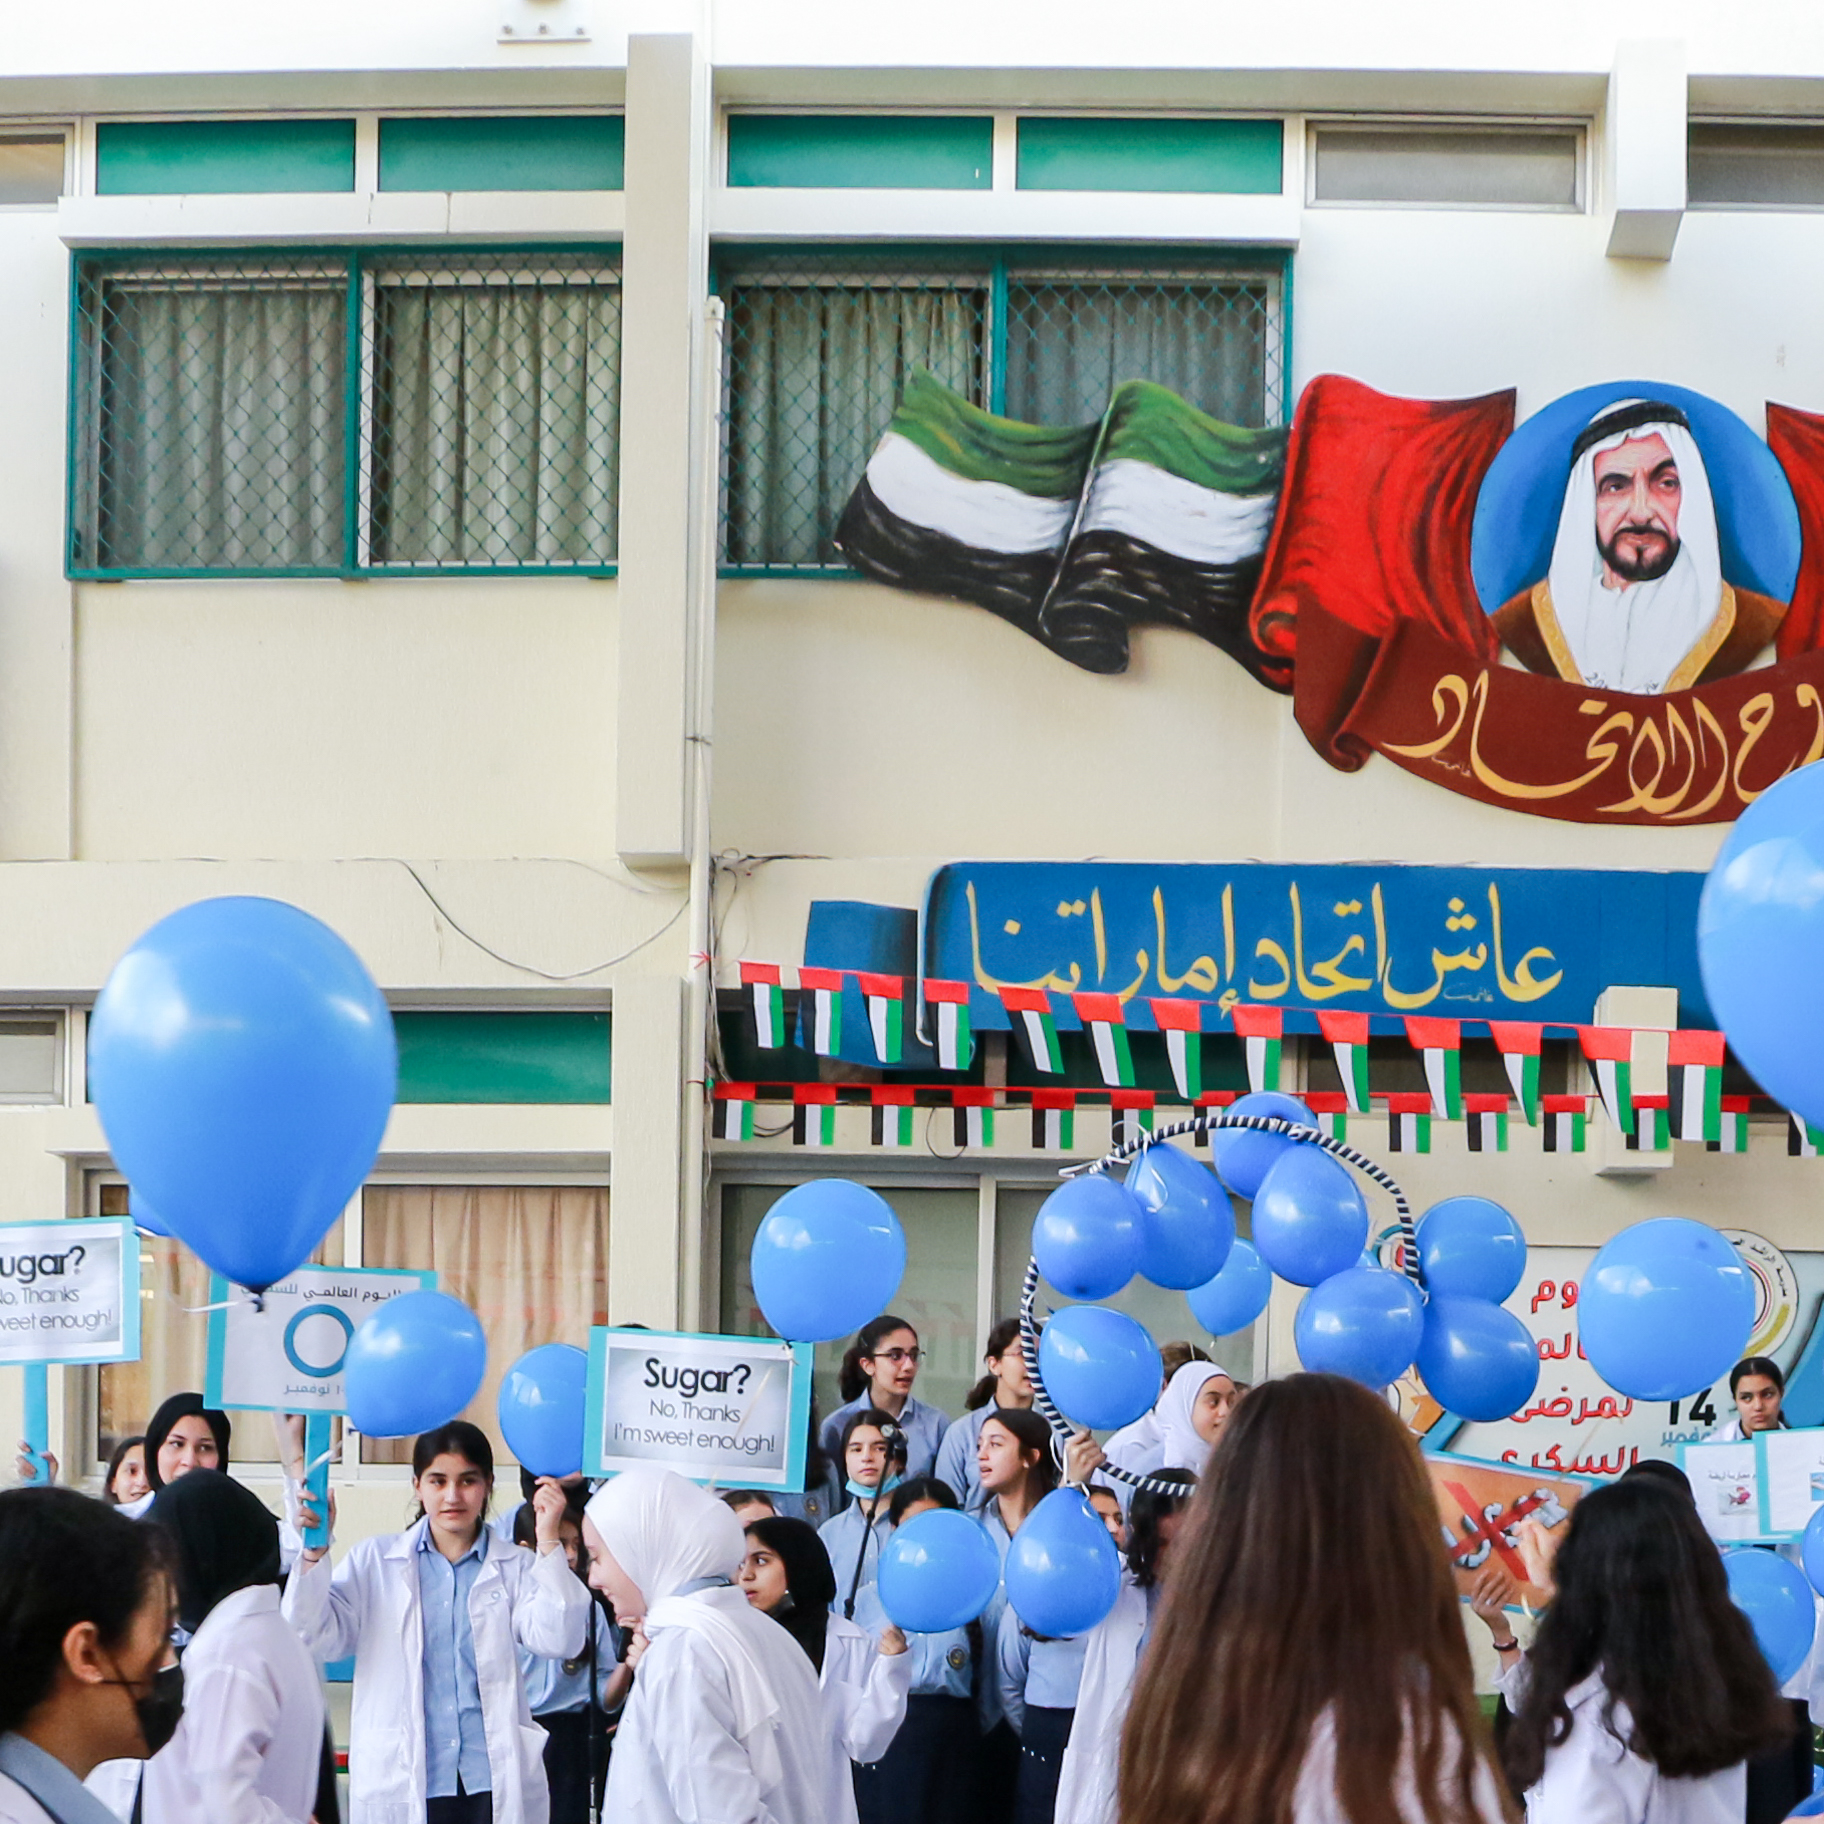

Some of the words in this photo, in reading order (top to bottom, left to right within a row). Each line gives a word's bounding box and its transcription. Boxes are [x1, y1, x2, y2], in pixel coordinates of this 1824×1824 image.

[965, 881, 1241, 1019] إماراتنا
[1248, 882, 1387, 1001] اتحاد
[1382, 882, 1563, 1009] عاش
[22, 1286, 80, 1305] Thanks
[303, 1286, 357, 1302] العالمي
[40, 1309, 112, 1331] enough!
[284, 1383, 330, 1396] نوفمبر
[644, 1357, 751, 1398] Sugar?
[650, 1399, 678, 1419] No,
[682, 1401, 741, 1423] Thanks
[1669, 1387, 1716, 1426] 14
[614, 1423, 641, 1441] I'm
[643, 1429, 694, 1447] sweet
[697, 1434, 775, 1455] enough!
